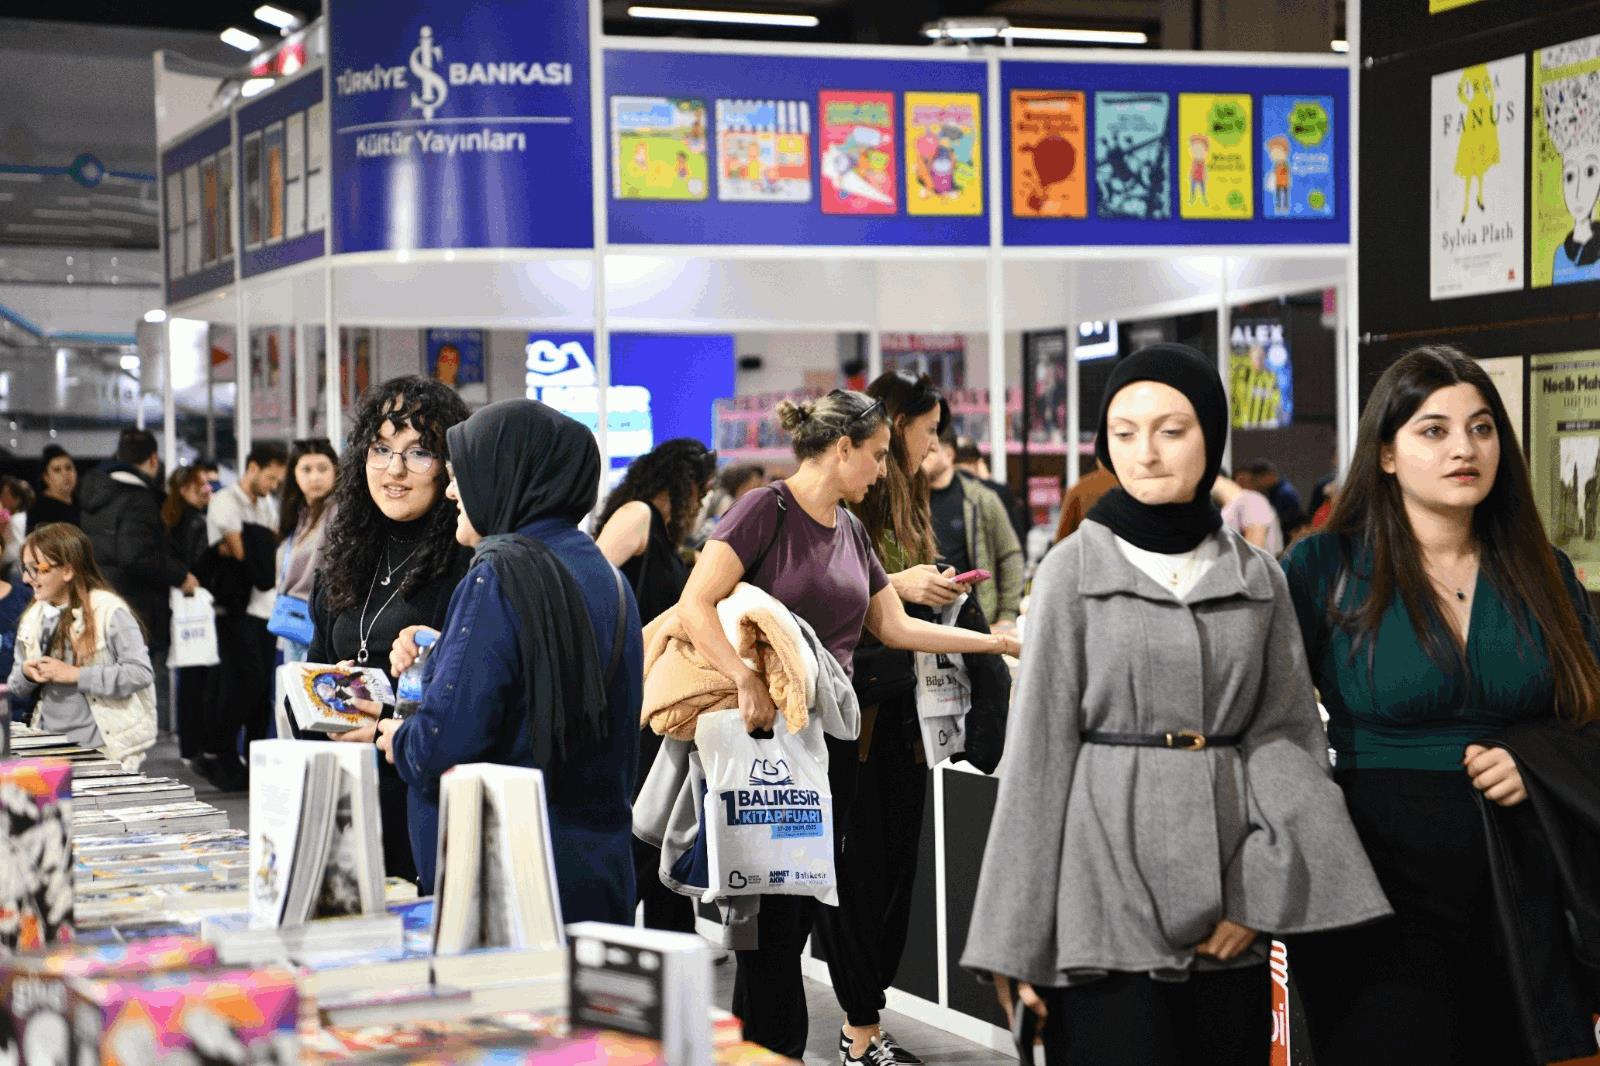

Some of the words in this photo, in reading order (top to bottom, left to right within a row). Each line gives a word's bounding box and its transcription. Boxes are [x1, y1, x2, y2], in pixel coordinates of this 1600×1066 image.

[336, 65, 407, 95] TÜRKİYE
[449, 62, 572, 85] BANKASI
[356, 131, 411, 157] Kültür
[416, 128, 527, 155] Yayınları
[1441, 227, 1478, 254] Sylvia
[1481, 221, 1514, 244] Plath
[1231, 324, 1284, 347] ALEX
[926, 675, 944, 687] Bilgi
[785, 809, 821, 824] FUARI
